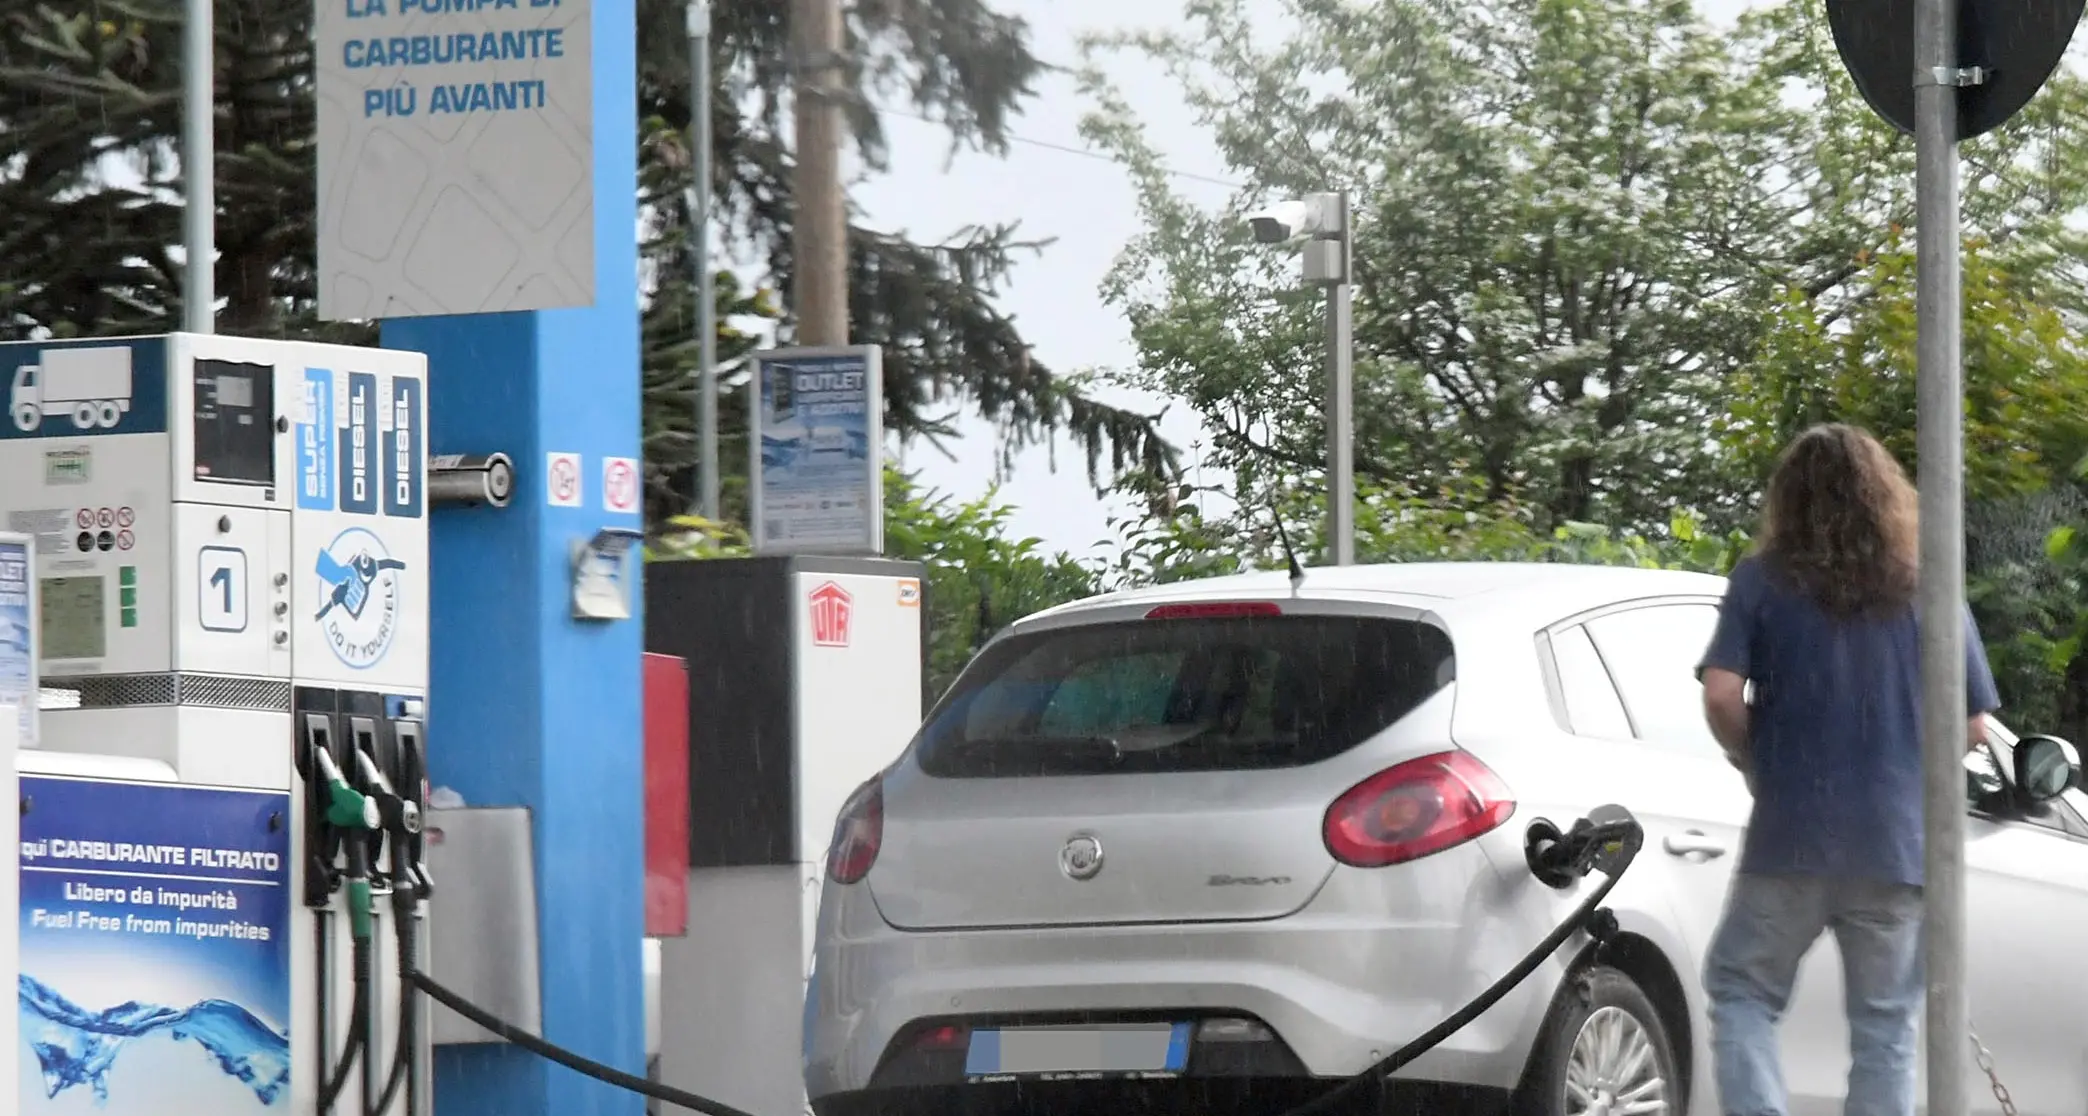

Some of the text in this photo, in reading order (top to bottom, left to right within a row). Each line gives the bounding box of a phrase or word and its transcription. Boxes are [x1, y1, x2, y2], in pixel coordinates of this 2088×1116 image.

[346, 0, 386, 18] LA
[343, 28, 564, 68] CARBURANTE
[364, 80, 545, 118] PIÙ AVANTI
[797, 372, 863, 392] OUTLET
[304, 380, 317, 497] SUPER
[352, 384, 365, 501] DIESEL
[396, 389, 410, 505] DIESEL
[210, 567, 231, 613] 1
[329, 578, 394, 659] DO IT YOURSELF
[20, 839, 279, 871] qui CARBURANTE FILTRATO
[64, 882, 237, 910] Libero da impurità
[32, 908, 270, 940] Fuel Free from impurities
